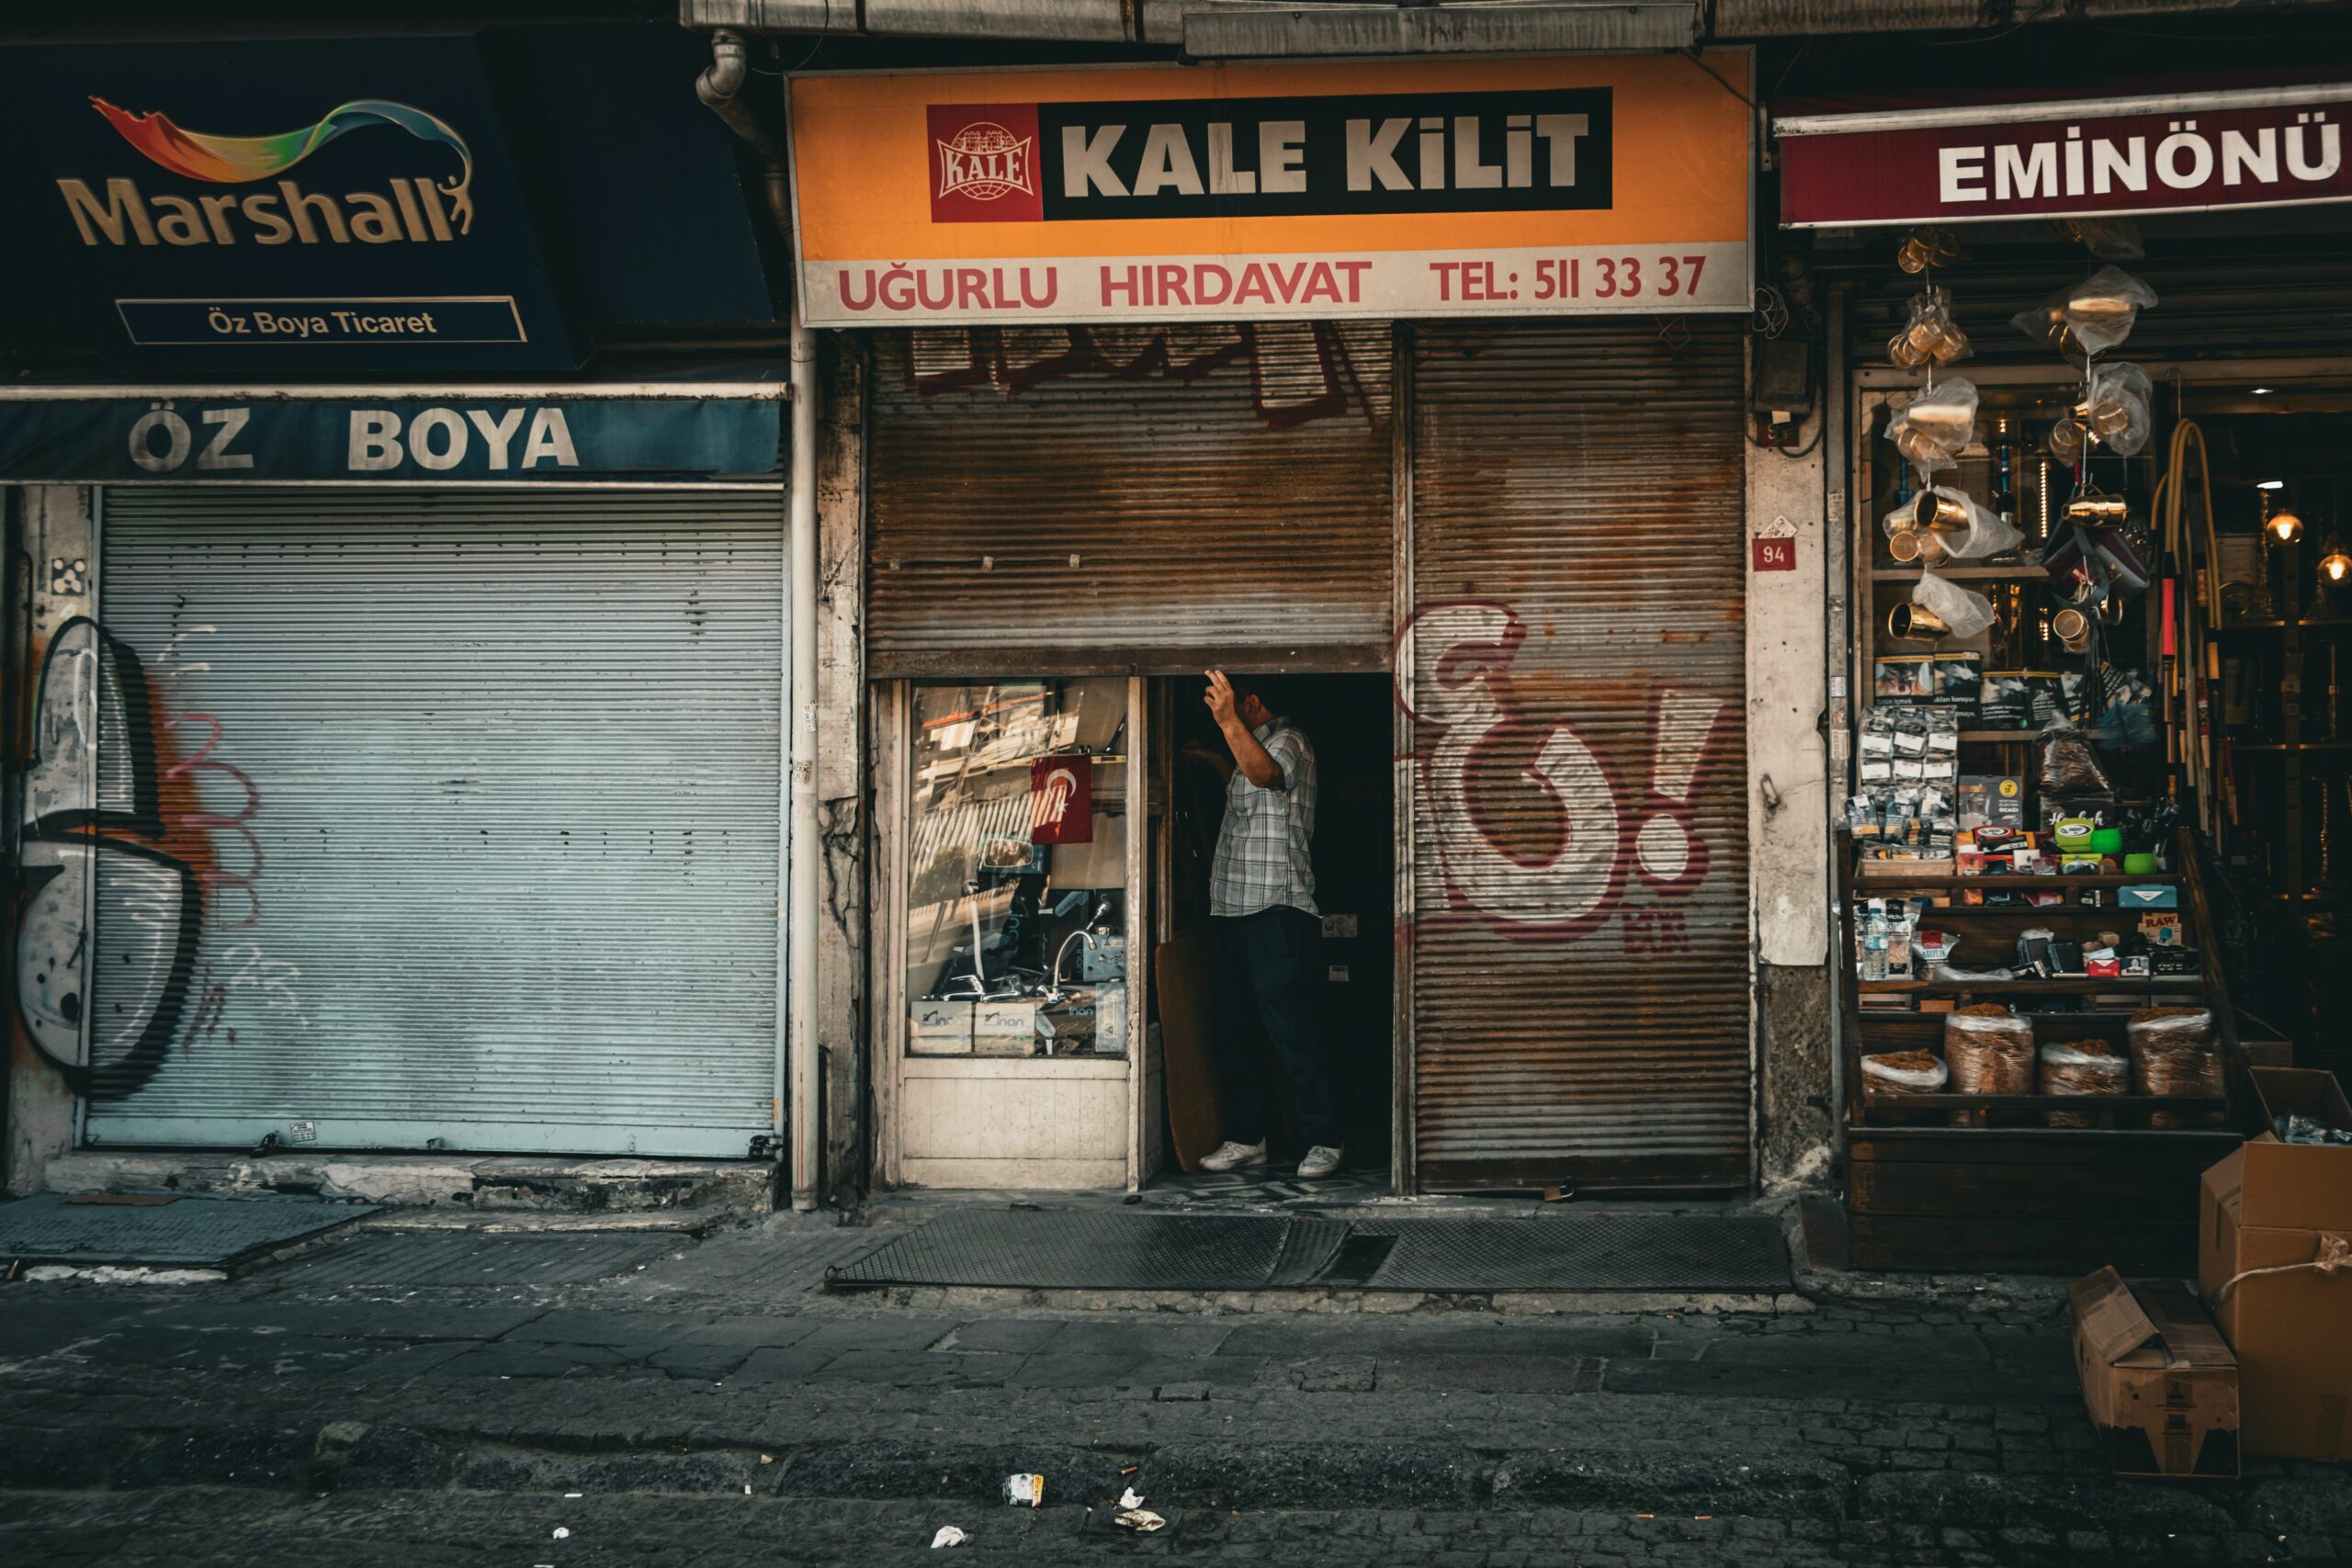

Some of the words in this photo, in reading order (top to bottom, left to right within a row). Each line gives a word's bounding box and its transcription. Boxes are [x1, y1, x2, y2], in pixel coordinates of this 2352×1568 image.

[944, 147, 1023, 189] KALE
[1061, 120, 1308, 198] KALE
[1939, 111, 2341, 203] EMİNÖNÜ
[56, 177, 455, 247] Marshall
[838, 263, 1058, 310] UĞURLU
[1102, 261, 1373, 308] HIRDAVAT
[1430, 260, 1519, 302] TEL:
[1595, 257, 1642, 298] 33
[1657, 255, 1706, 297] 37
[208, 307, 252, 335] Öz
[253, 310, 330, 339] Boya
[332, 311, 437, 335] Ticaret
[128, 402, 254, 473] ÖZ
[347, 407, 580, 472] BOYA
[1763, 546, 1784, 563] 94
[2145, 916, 2177, 929] RAW
